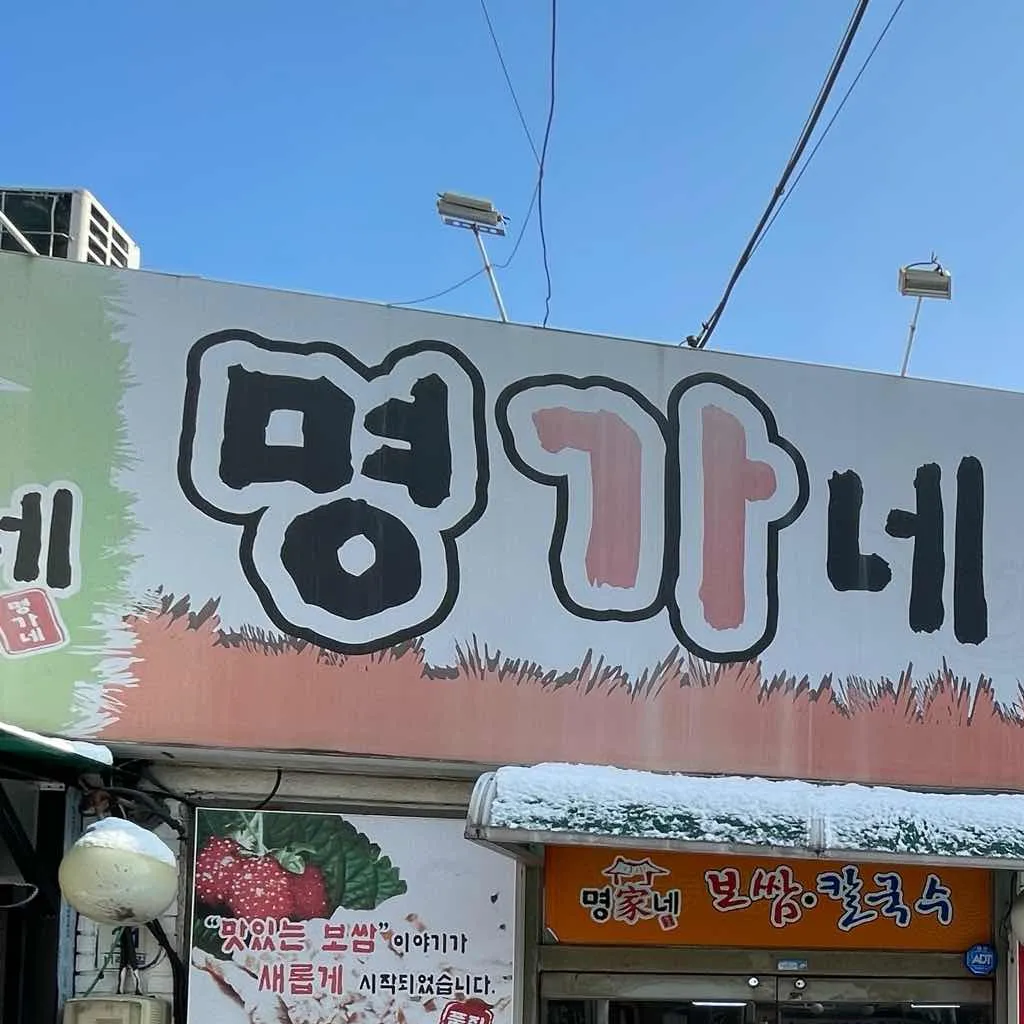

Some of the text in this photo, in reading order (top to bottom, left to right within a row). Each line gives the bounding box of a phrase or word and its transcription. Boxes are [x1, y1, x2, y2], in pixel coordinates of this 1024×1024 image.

[177, 328, 988, 664] 명가네
[8, 597, 46, 643] 명가네
[394, 932, 469, 955] 이야기가
[972, 953, 992, 965] ADT
[257, 962, 496, 997] 새롭게 시작되었습니다.
